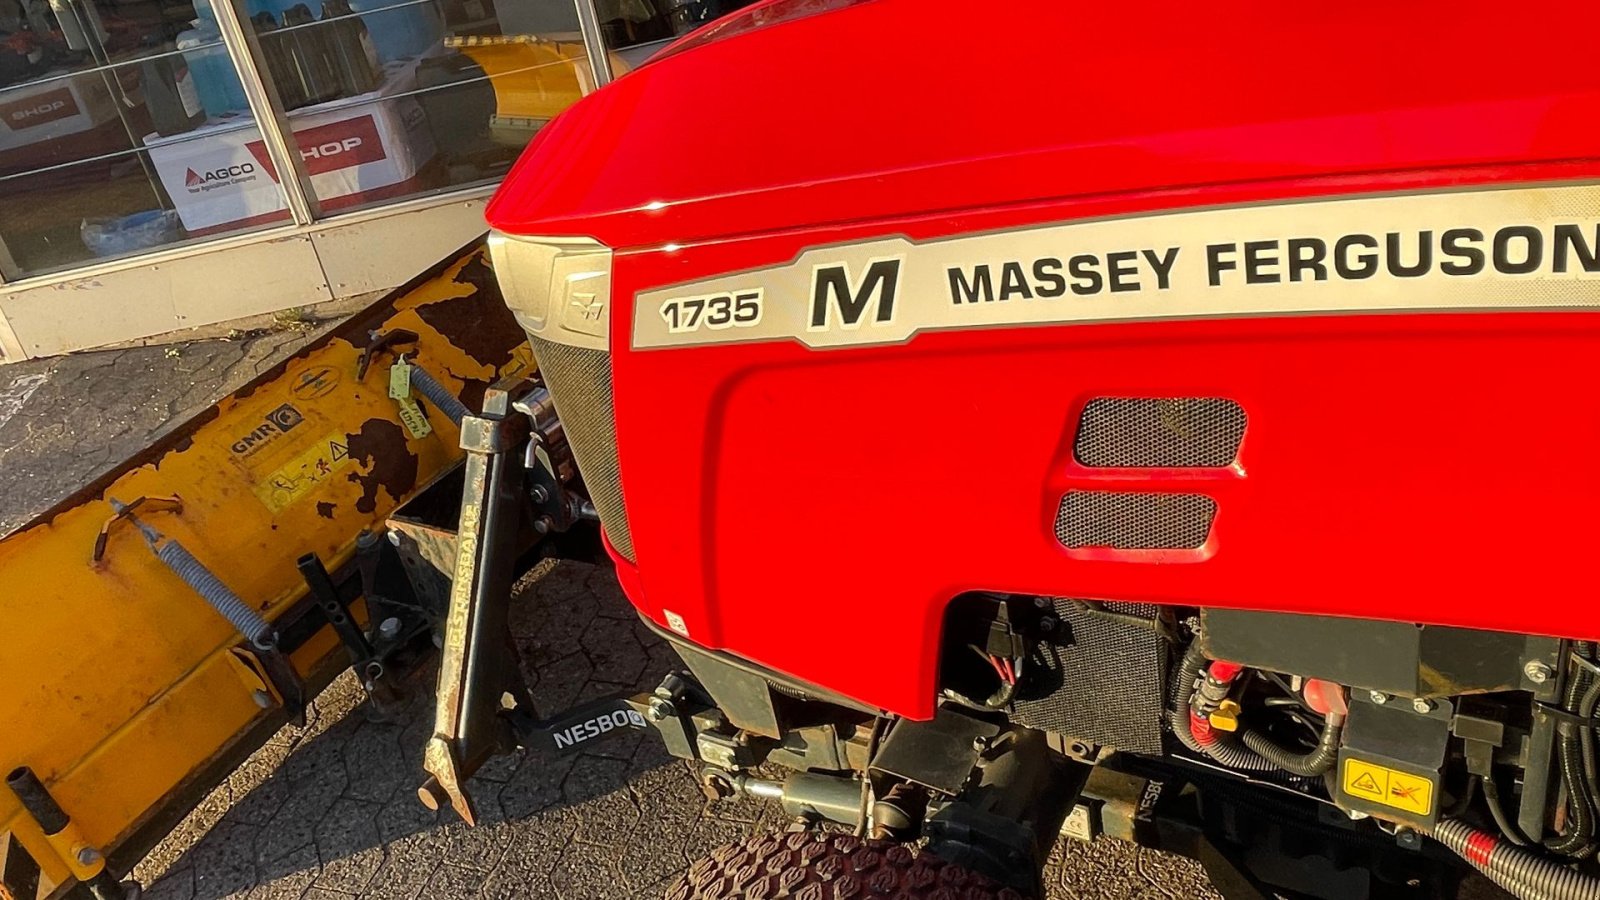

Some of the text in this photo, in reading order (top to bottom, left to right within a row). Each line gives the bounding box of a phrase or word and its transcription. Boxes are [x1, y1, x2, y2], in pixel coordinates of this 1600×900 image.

[12, 101, 65, 120] SHOP
[300, 137, 362, 161] HOP
[205, 163, 255, 182] AGCO
[231, 175, 257, 186] Company
[948, 223, 1600, 305] MASSEY FERGUSON
[811, 258, 900, 327] M
[663, 293, 760, 329] 1735
[231, 424, 276, 454] GMR
[553, 709, 629, 749] NESBO
